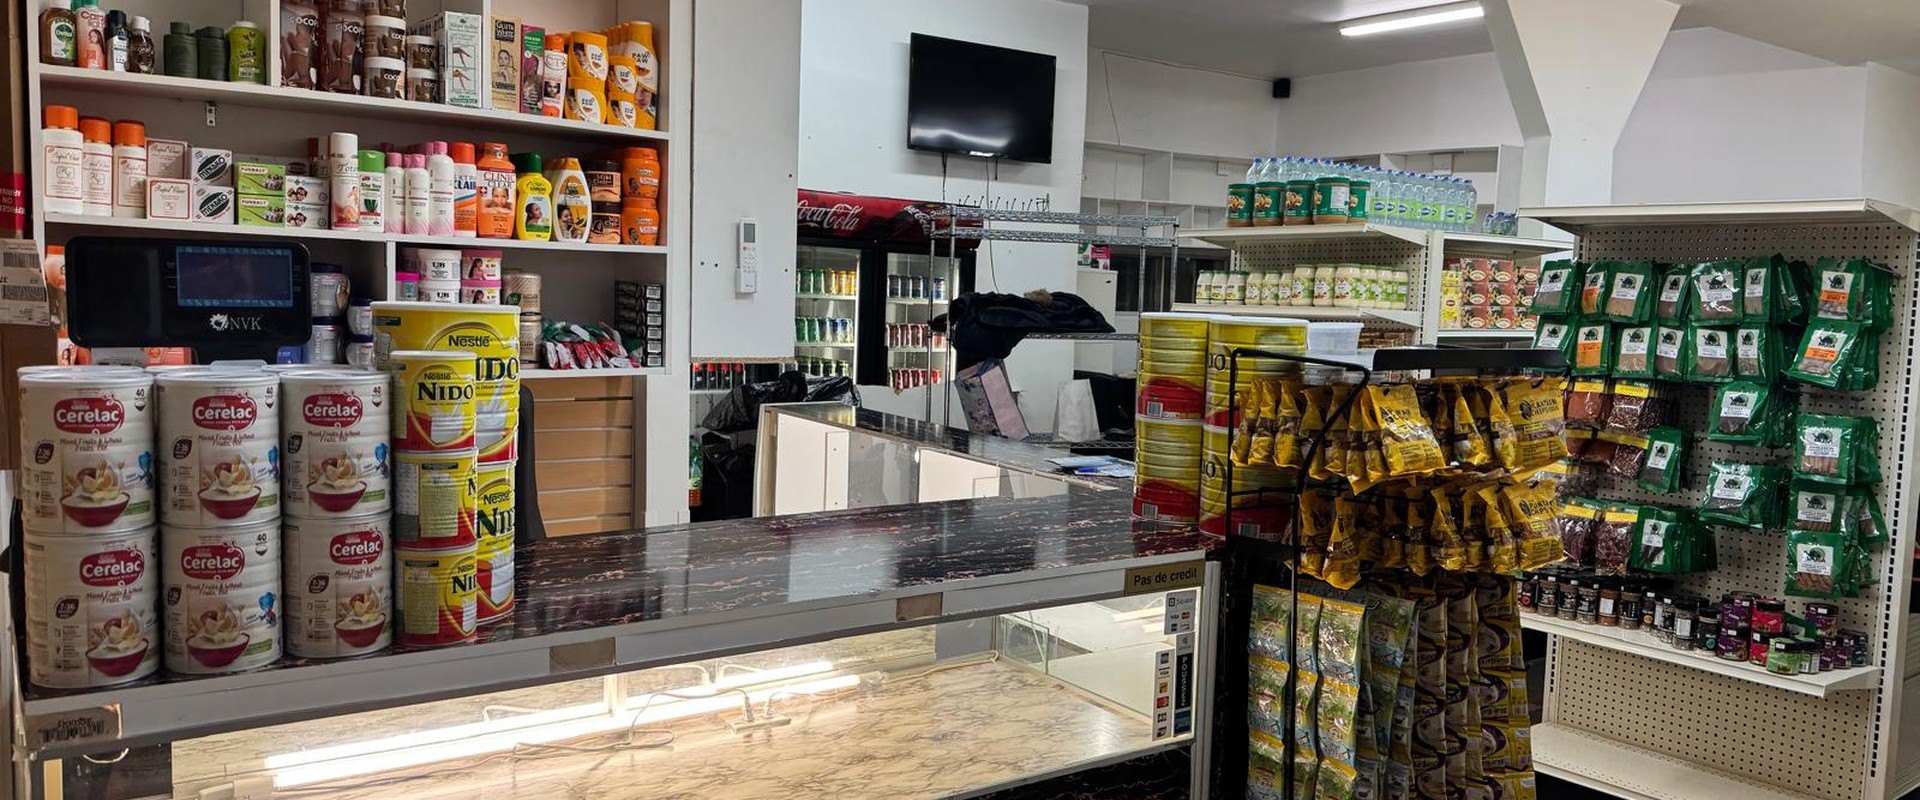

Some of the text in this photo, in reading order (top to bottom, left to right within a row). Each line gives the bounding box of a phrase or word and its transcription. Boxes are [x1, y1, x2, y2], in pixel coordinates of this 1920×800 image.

[229, 315, 262, 331] NVK
[417, 382, 474, 401] NIDO
[56, 408, 120, 423] Cerelac
[195, 406, 253, 420] Cerelac
[305, 403, 358, 417] Cerelac
[331, 539, 380, 557] Cerelac
[81, 559, 141, 578] Cerelac
[182, 554, 240, 570] Cerelac
[1133, 574, 1152, 587] Pas
[1154, 571, 1167, 584] de
